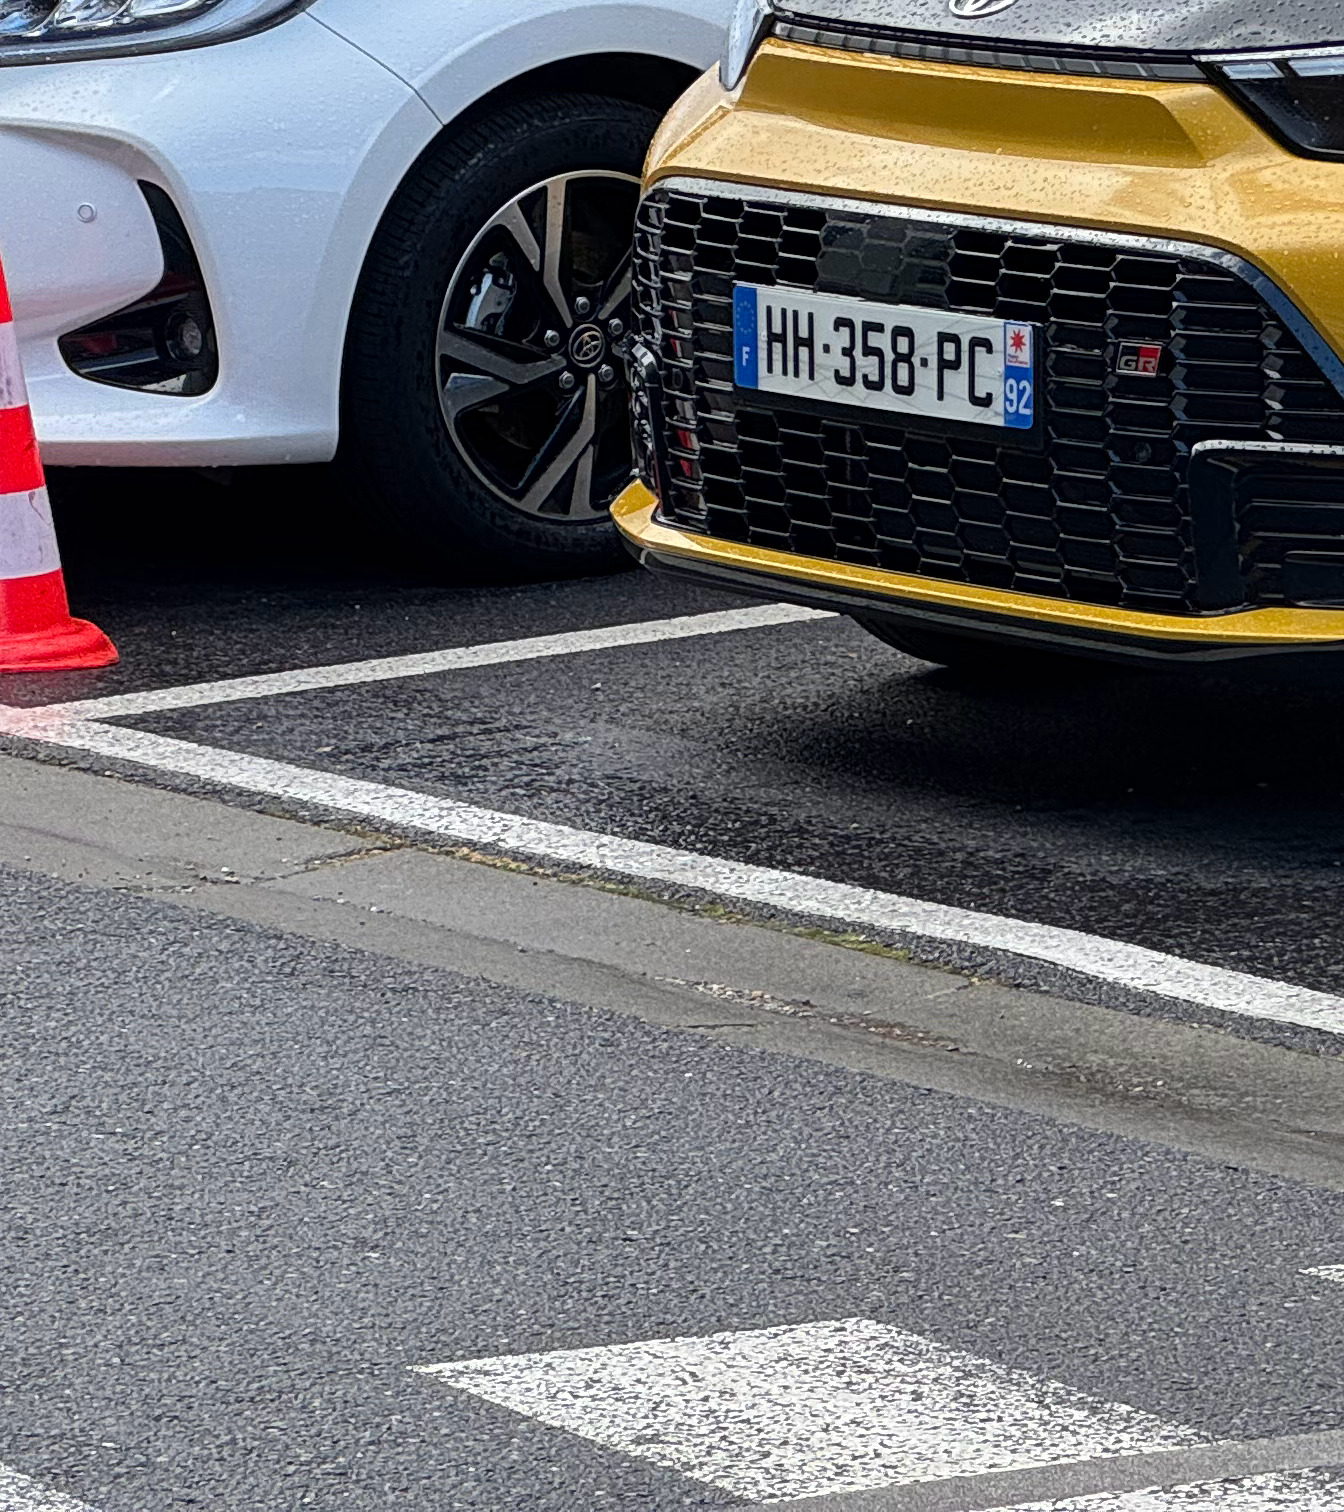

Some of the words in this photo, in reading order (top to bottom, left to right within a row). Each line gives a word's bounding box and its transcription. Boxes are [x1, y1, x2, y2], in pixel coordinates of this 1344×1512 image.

[741, 346, 751, 367] F
[1120, 355, 1156, 373] GR
[1005, 378, 1032, 415] 92
